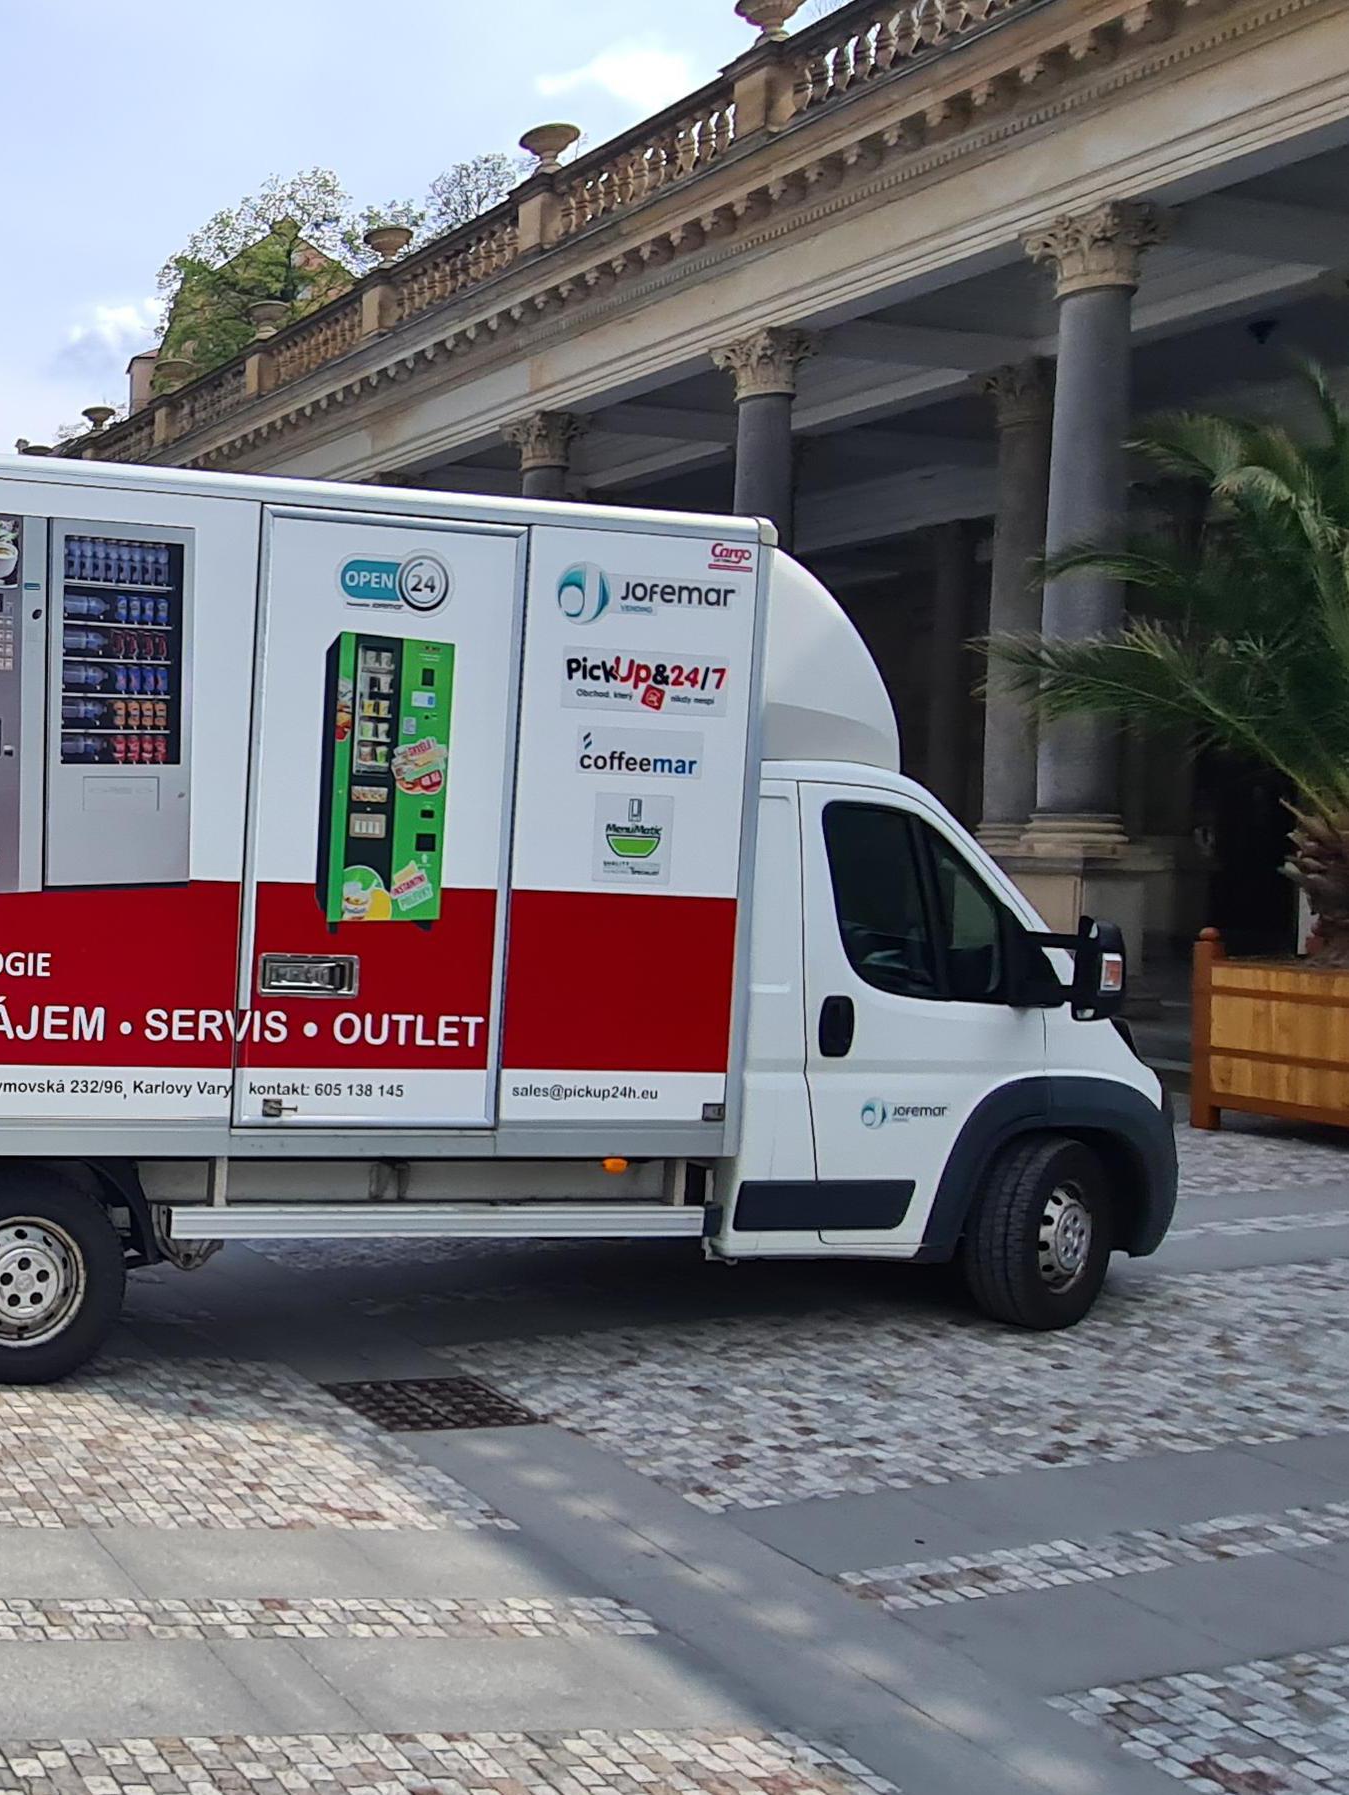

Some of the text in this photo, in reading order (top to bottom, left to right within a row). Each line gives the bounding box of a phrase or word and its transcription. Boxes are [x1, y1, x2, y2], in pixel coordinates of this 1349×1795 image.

[711, 542, 752, 564] Cargo
[345, 570, 436, 593] OPEN 24
[566, 655, 727, 691] PickUp&24/7
[579, 750, 698, 775] coffeemar
[144, 1008, 288, 1043] SERVIS
[332, 1012, 485, 1048] OUTLET
[133, 1081, 193, 1097] Karlovy
[197, 1081, 234, 1098] Vary
[248, 1082, 310, 1097] kontakt:
[314, 1082, 342, 1096] 605
[347, 1083, 373, 1097] 138
[378, 1083, 404, 1098] 145
[511, 1083, 659, 1102] sales@pickup24h.eu
